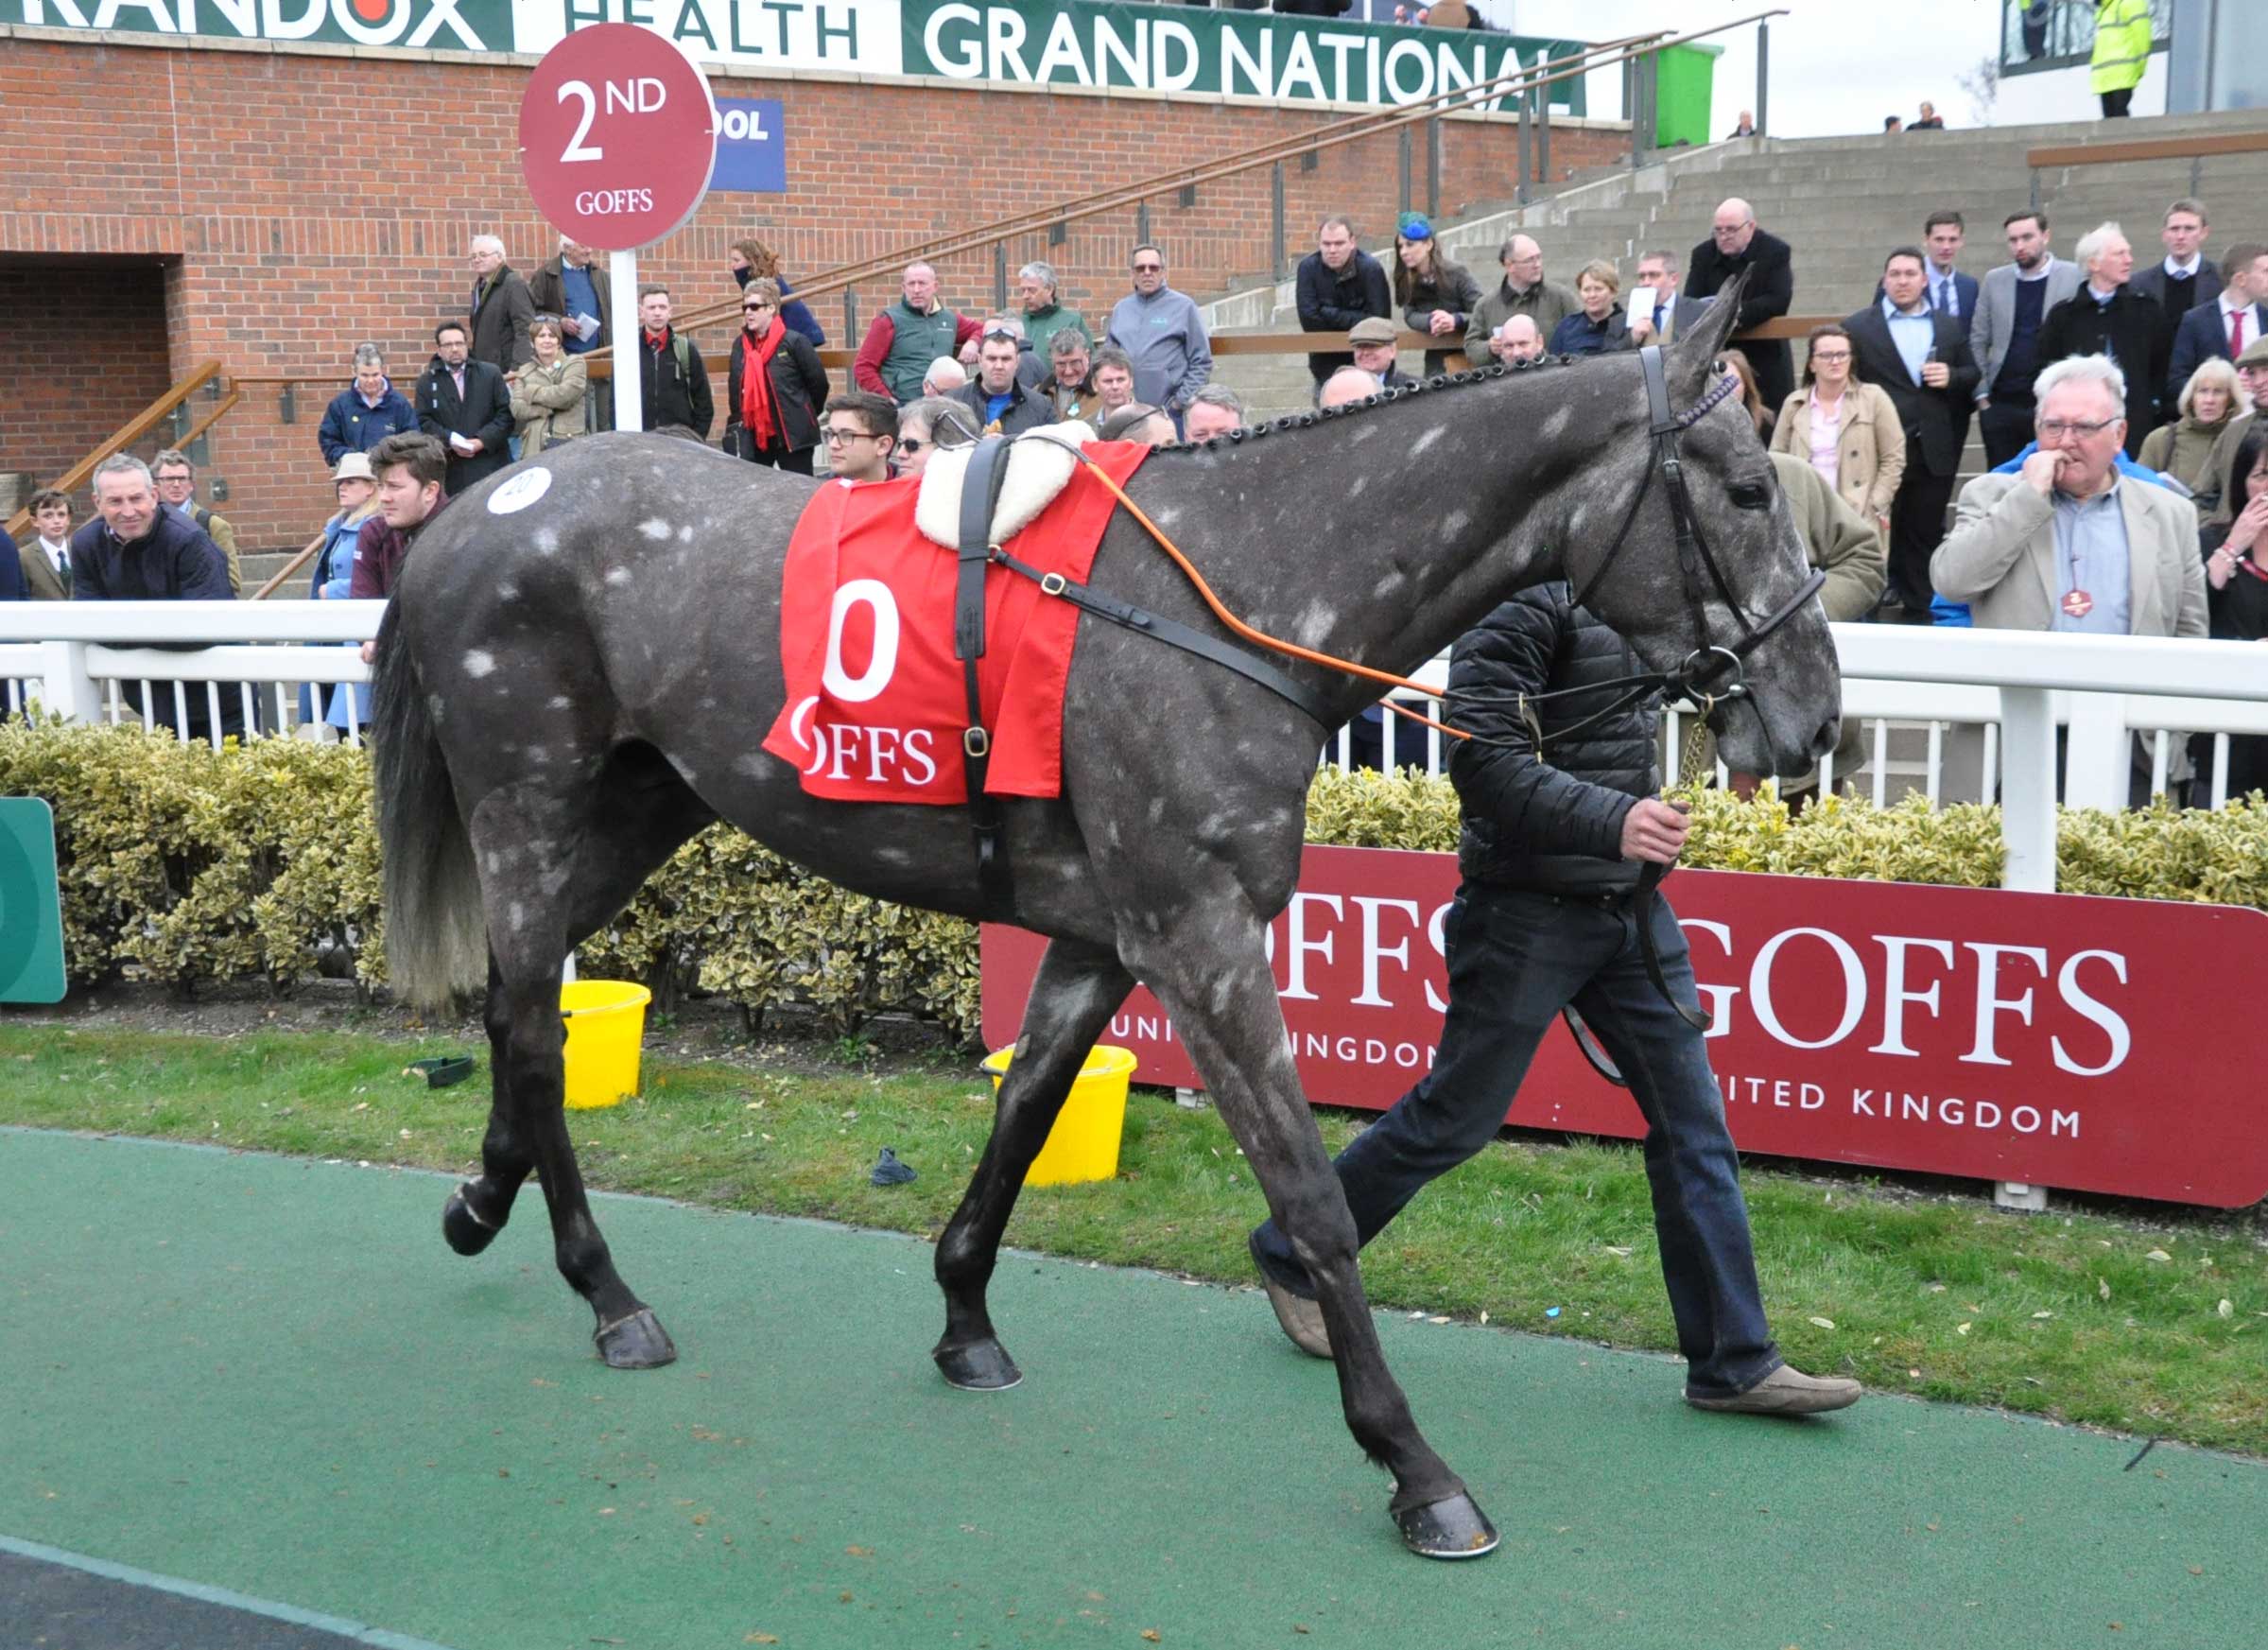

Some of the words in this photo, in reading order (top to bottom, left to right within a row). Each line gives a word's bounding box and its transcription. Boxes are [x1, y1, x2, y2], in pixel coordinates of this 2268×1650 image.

[923, 2, 1200, 92] GRAND
[1221, 25, 1570, 115] NATIONAL
[575, 188, 653, 216] GOFFS
[1677, 918, 2131, 1076] GOFFS
[1713, 1074, 1826, 1109] ITED
[1852, 1088, 2081, 1138] KINGDOM
